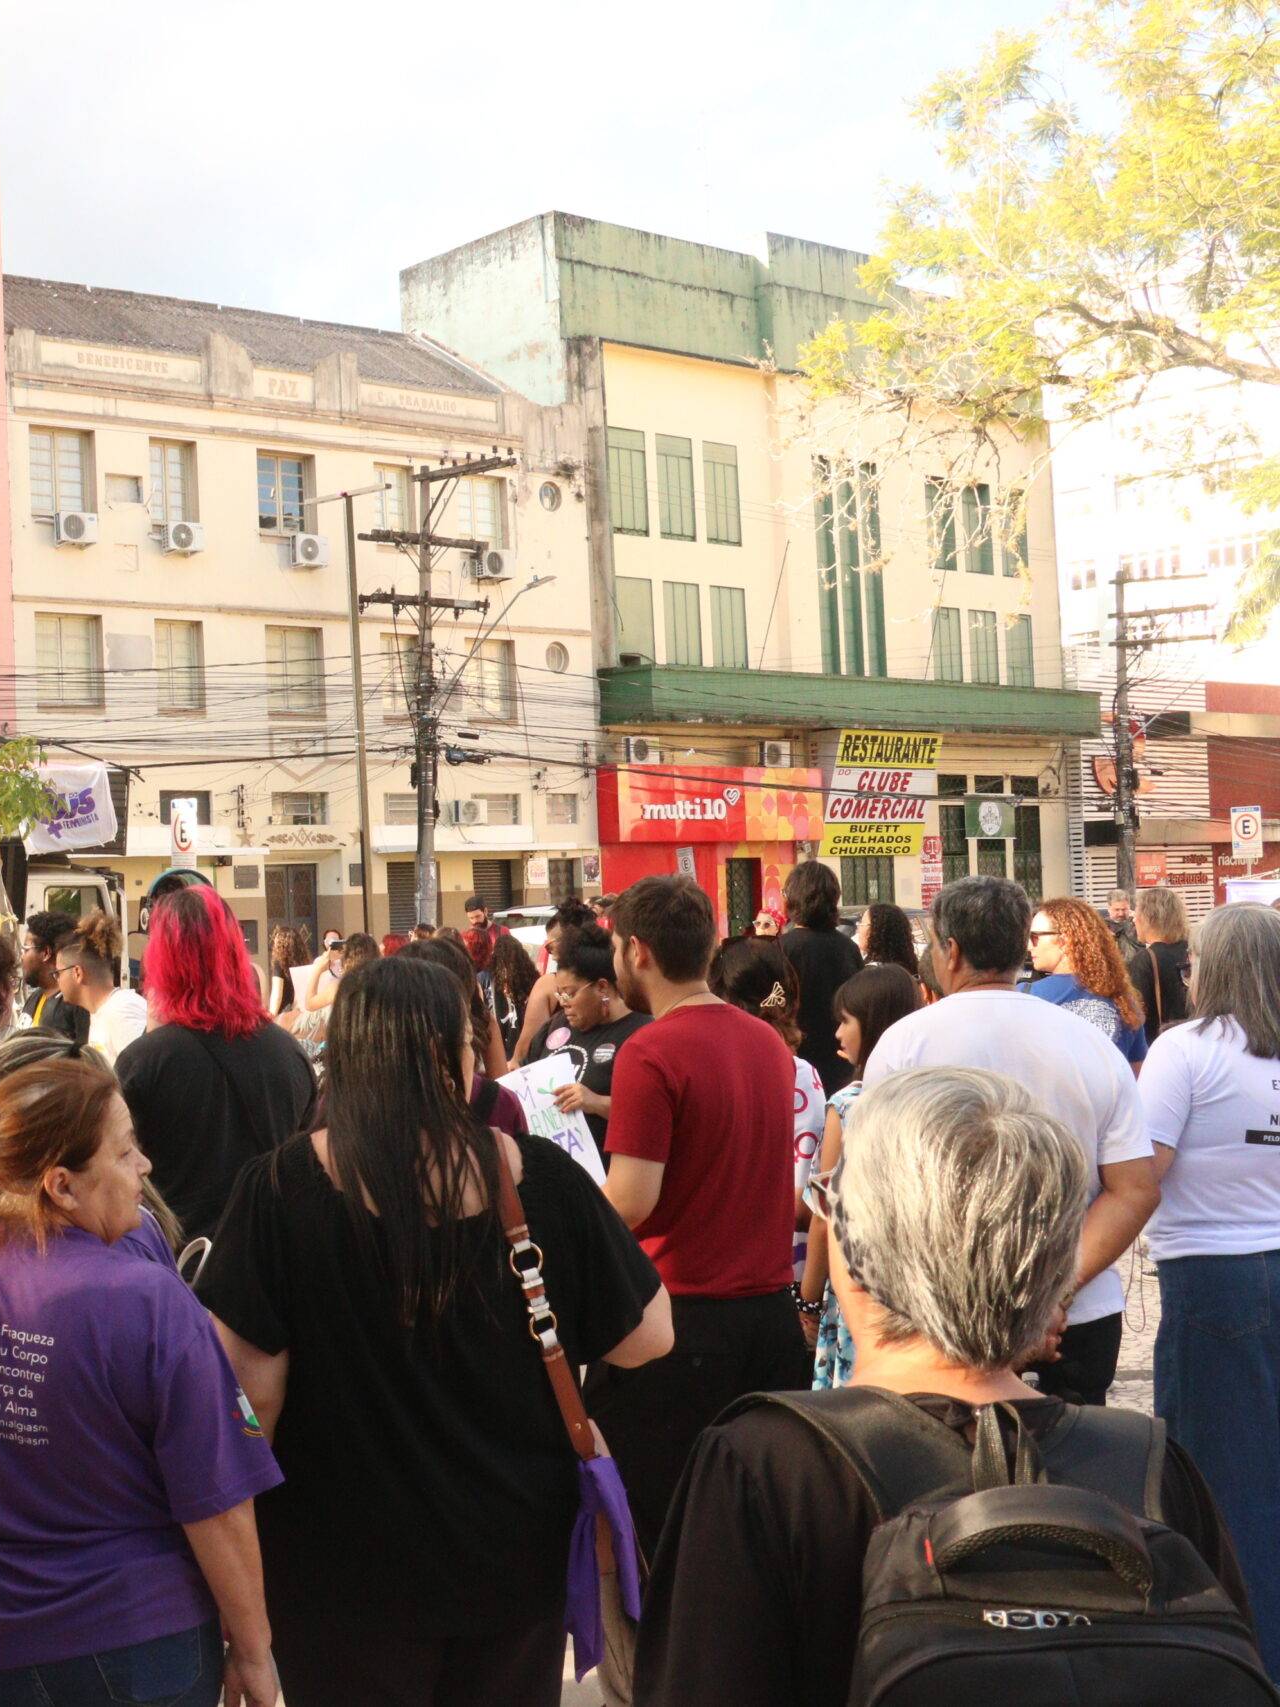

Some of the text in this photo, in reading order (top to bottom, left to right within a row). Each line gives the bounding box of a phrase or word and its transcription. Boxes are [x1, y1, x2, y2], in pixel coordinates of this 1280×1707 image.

[268, 378, 298, 398] PAZ
[840, 734, 939, 764] RESTAURANTE
[857, 770, 912, 792] CLUBE
[642, 797, 727, 821] multi10
[829, 797, 926, 820] COMERCIAL
[849, 825, 900, 833] BUFETT
[832, 835, 912, 844] GRELHADOS
[829, 845, 911, 855] CHURRASCO
[1, 1323, 55, 1347] Fraqueza
[12, 1345, 48, 1366] Corpo
[18, 1385, 34, 1399] da
[4, 1401, 38, 1418] Alma
